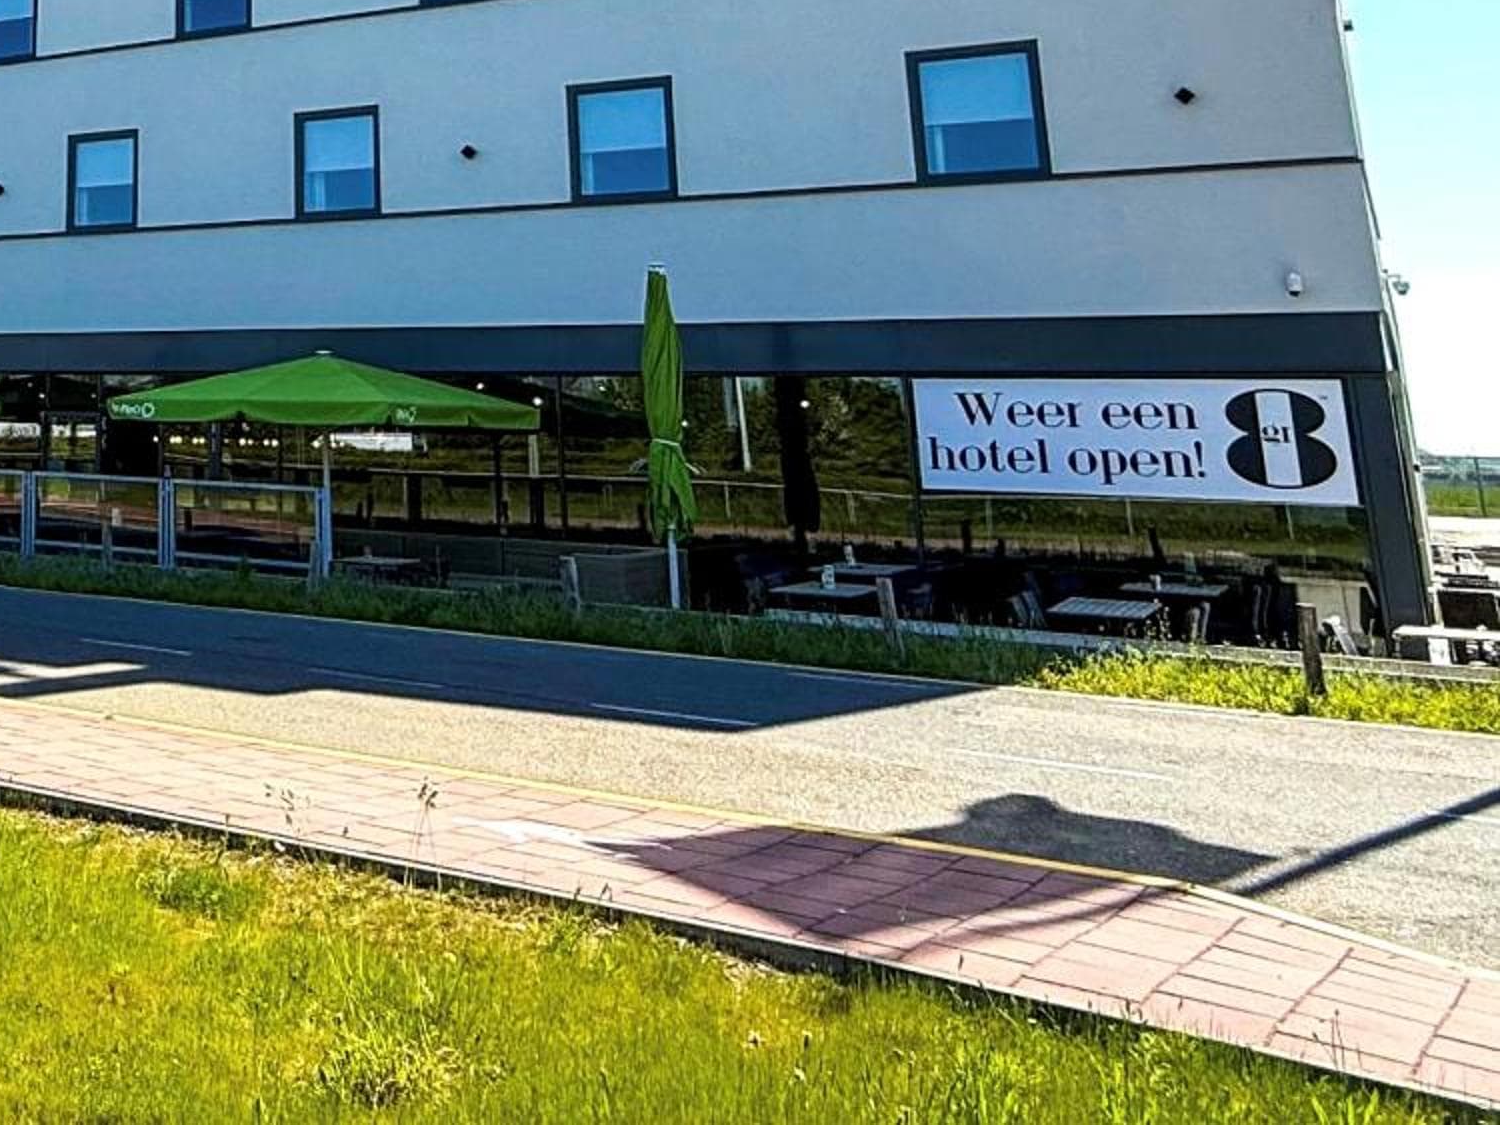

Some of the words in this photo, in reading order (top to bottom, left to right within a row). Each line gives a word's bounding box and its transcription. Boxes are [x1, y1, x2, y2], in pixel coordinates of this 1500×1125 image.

[954, 391, 1082, 429] Weer
[1101, 399, 1199, 431] een
[928, 436, 1050, 475] hotel
[1067, 440, 1207, 486] open!
